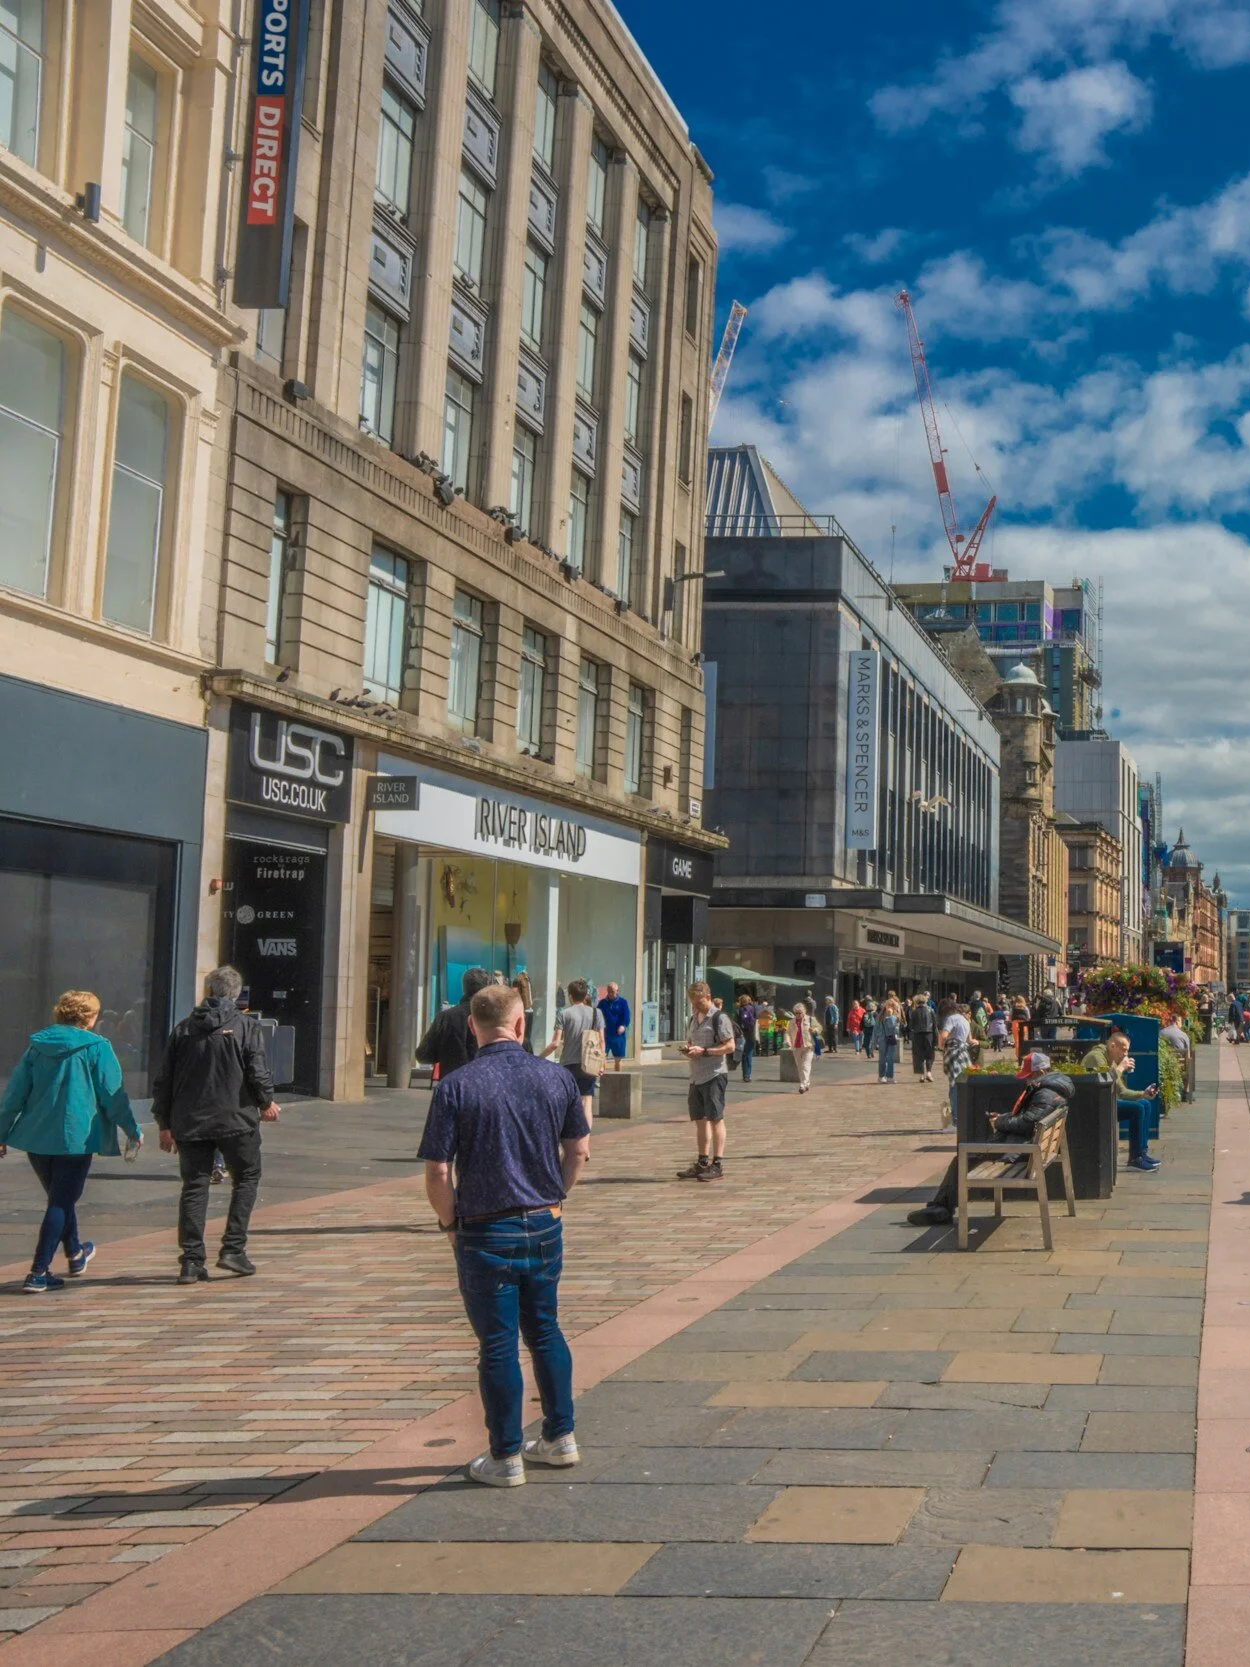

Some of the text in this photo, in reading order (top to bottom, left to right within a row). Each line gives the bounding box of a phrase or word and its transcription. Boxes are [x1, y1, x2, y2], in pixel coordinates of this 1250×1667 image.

[261, 0, 289, 87] PORTS
[252, 105, 281, 218] DIRECT
[854, 657, 871, 813] MARKS & SPENCER
[250, 712, 345, 786] USC
[262, 776, 326, 812] USC.CO.UK
[377, 782, 406, 792] RIVER
[373, 794, 409, 804] ISLAND
[480, 798, 586, 856] RIVER ISLAND
[852, 829, 869, 837] M&S
[257, 867, 305, 881] Firetrap
[672, 857, 692, 879] GAME
[257, 911, 294, 919] GREEN
[257, 938, 297, 957] VANS
